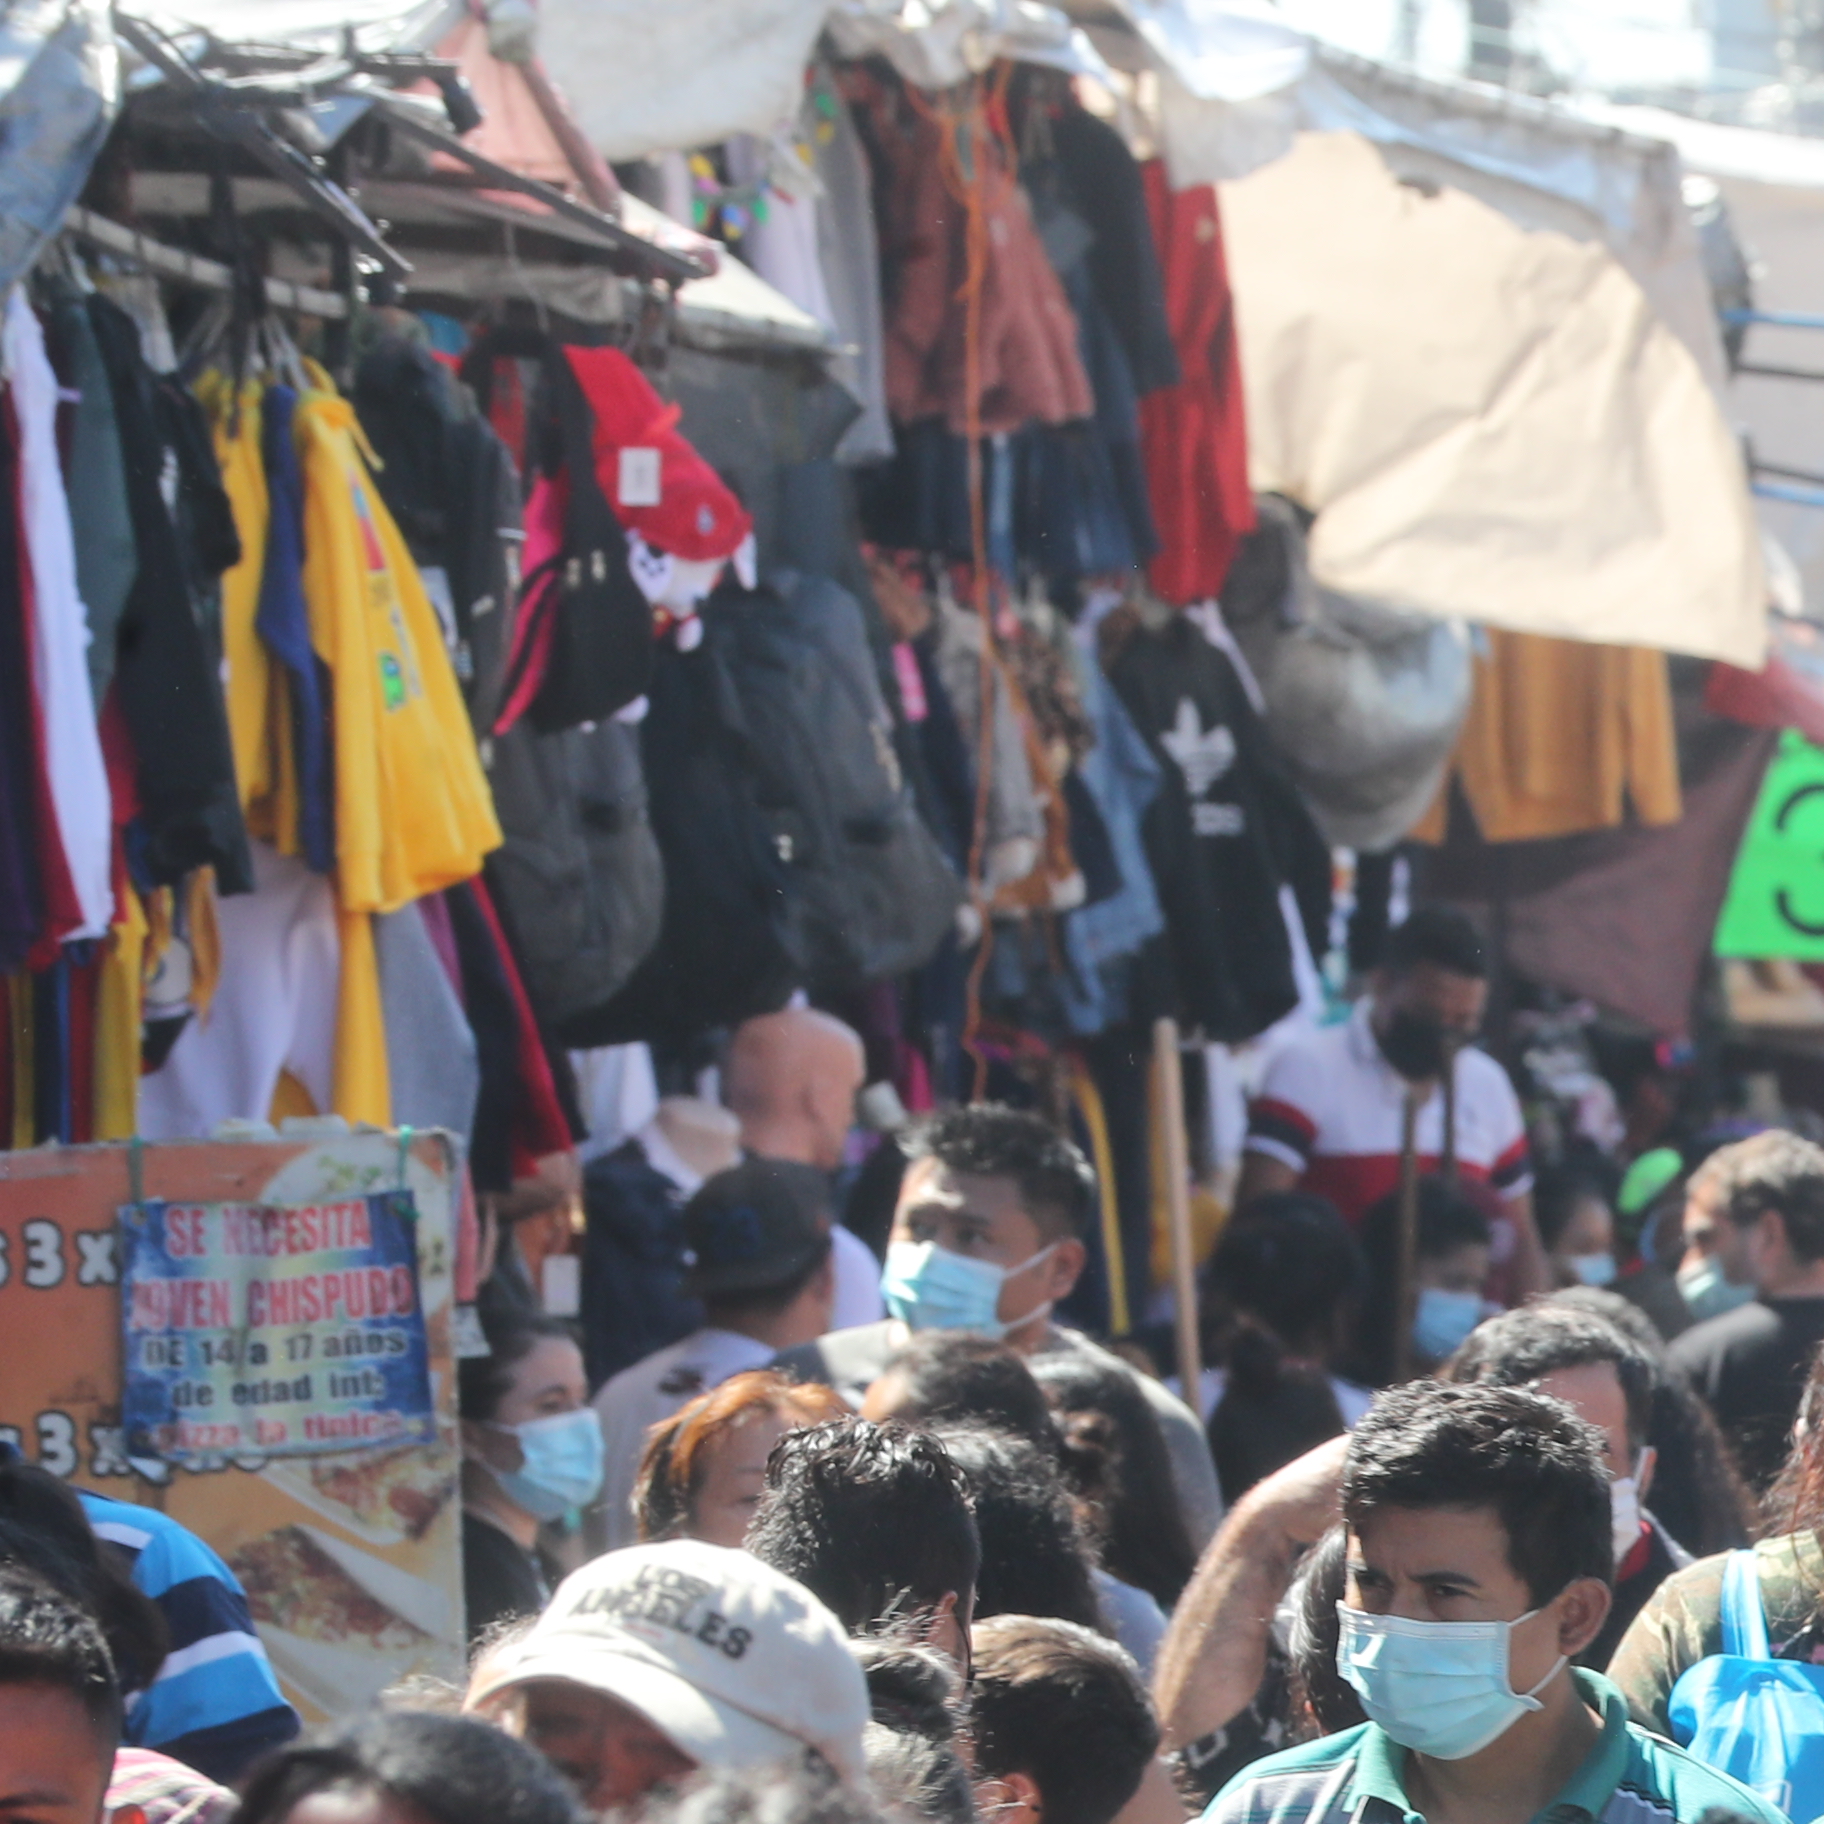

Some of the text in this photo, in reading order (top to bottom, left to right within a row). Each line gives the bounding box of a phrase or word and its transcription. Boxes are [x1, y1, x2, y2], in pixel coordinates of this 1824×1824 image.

[23, 1219, 64, 1288] 3
[166, 1199, 371, 1257] SE NECESITA
[131, 1264, 413, 1329] JOVEN CHISPUDO
[145, 1338, 184, 1367] DE
[250, 1342, 268, 1366] a
[286, 1333, 314, 1361] 17
[322, 1328, 407, 1359] años
[172, 1381, 213, 1407] de
[231, 1374, 313, 1406] edad
[37, 1410, 76, 1477] 3
[634, 1564, 713, 1600] LOS
[568, 1588, 754, 1660] ANGELES
